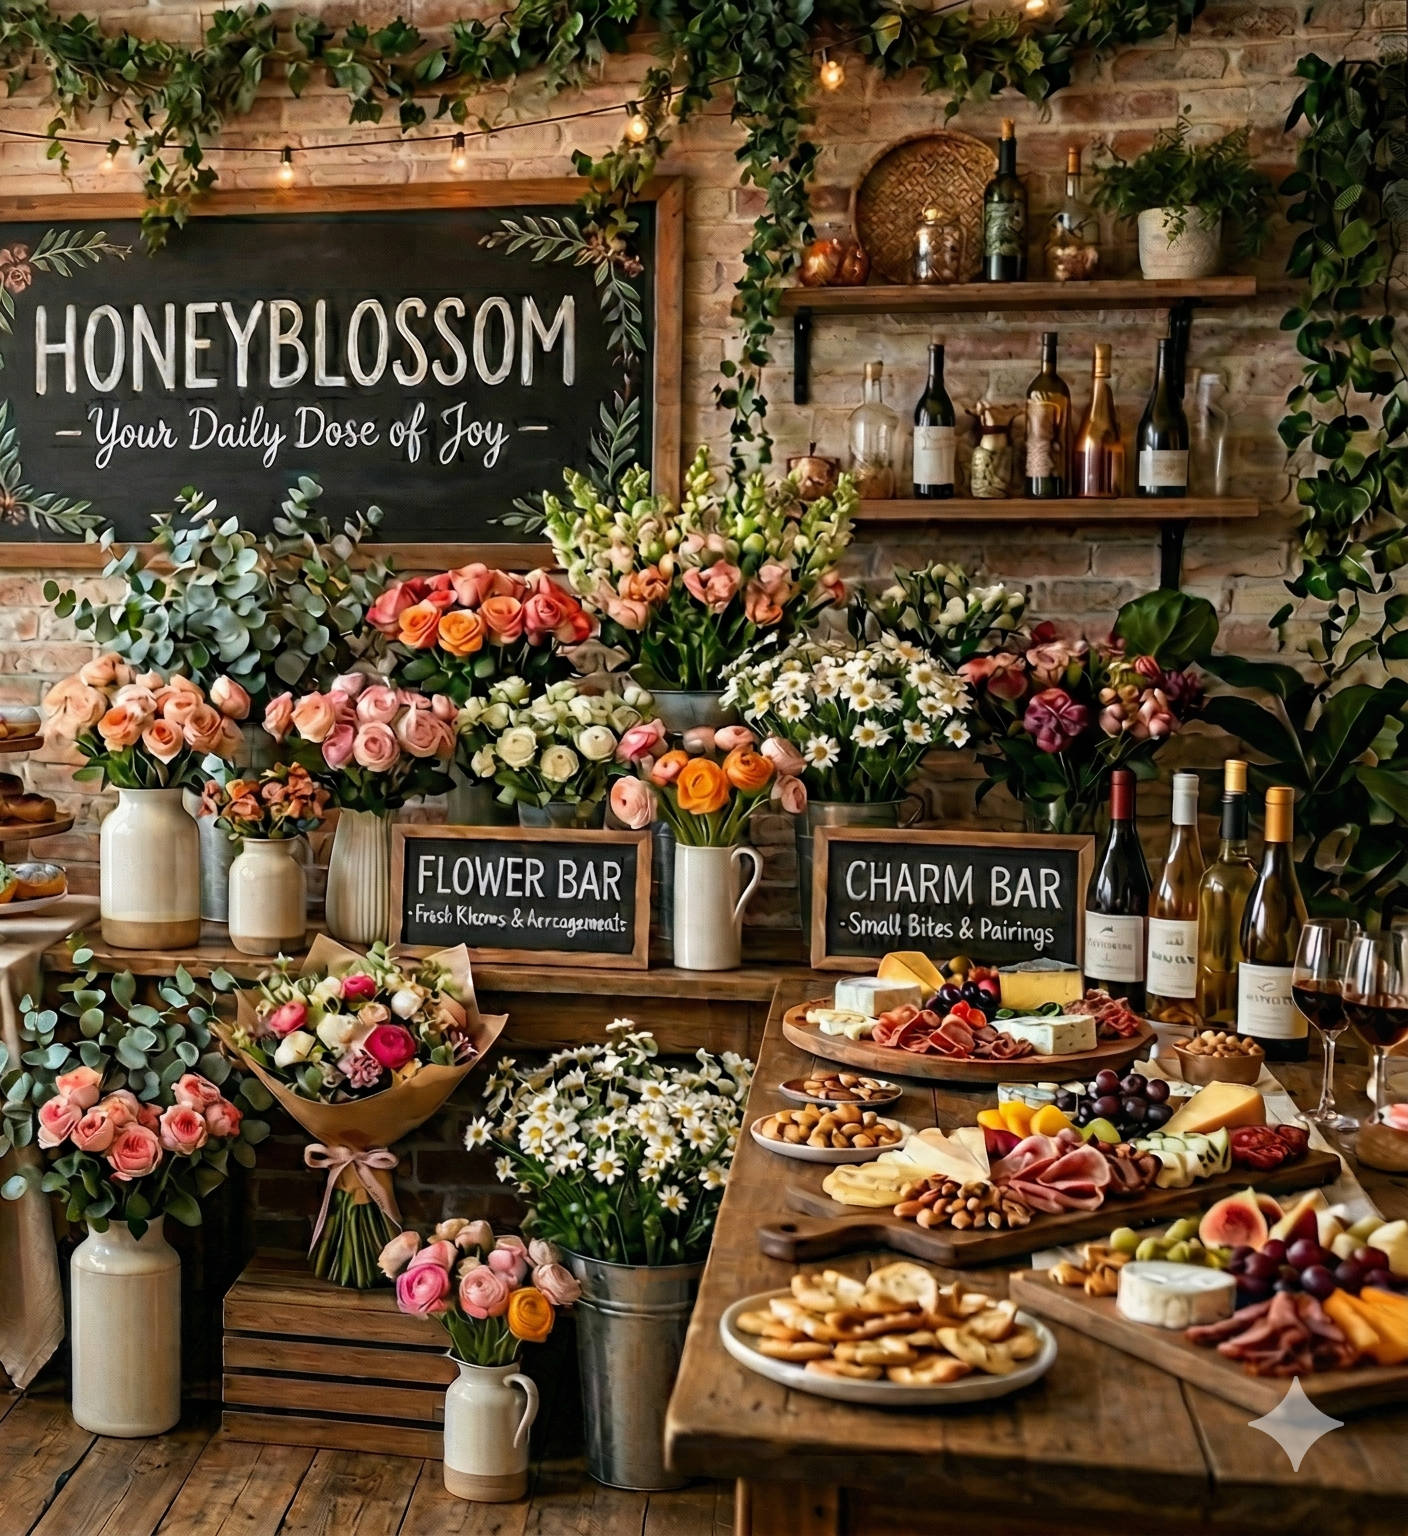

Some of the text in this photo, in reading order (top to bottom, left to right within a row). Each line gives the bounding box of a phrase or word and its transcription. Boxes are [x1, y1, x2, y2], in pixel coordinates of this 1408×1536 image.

[35, 294, 575, 396] HONEYBLOSSOM
[87, 401, 510, 469] Your Daily Dose of Joy
[418, 855, 622, 901] FLOWER BAR
[845, 860, 1062, 909] CHARM BAR
[415, 903, 453, 924] Fresh
[510, 907, 525, 928] &
[848, 911, 1055, 952] Small Bites & Pairings
